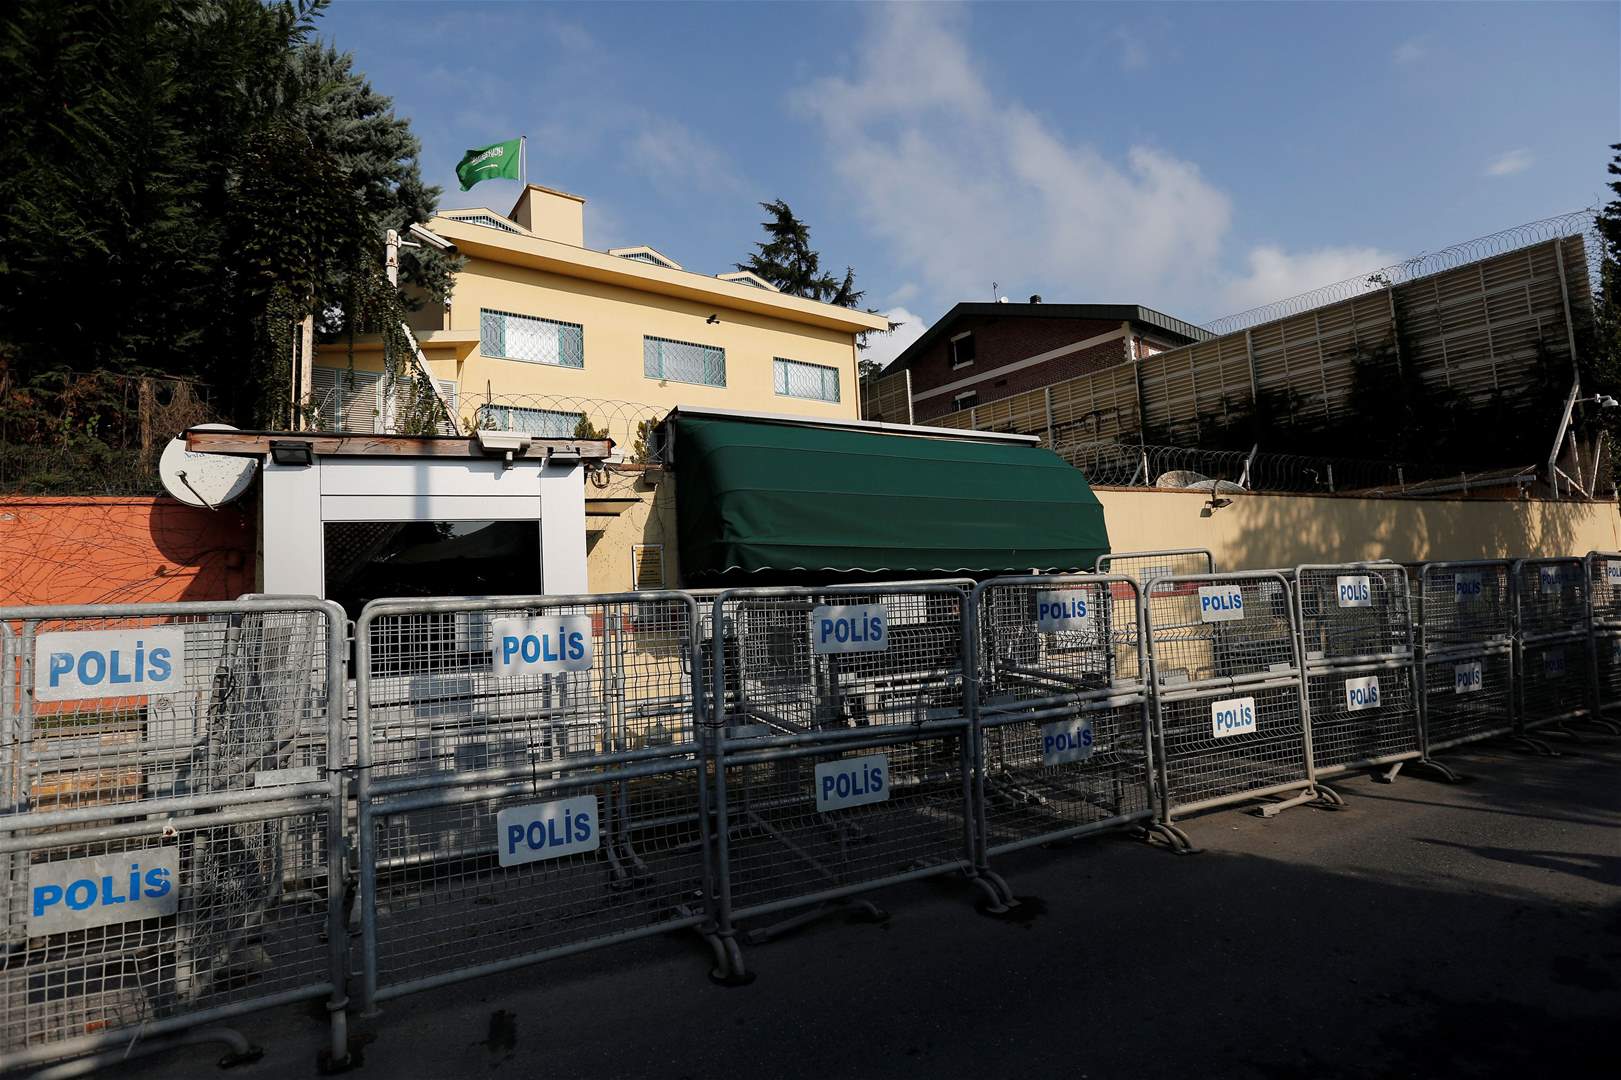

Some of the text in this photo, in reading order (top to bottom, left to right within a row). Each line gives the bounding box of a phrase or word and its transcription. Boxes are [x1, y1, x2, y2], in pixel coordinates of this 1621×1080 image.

[1202, 592, 1242, 611] POLİS
[1341, 581, 1368, 601] POLİS
[1040, 598, 1086, 621] POLİS
[821, 612, 883, 643] POLİS
[503, 627, 585, 665] POLİS
[49, 641, 172, 687] POLİS
[1457, 667, 1480, 688] POLİS
[1350, 683, 1377, 706] POLİS
[1217, 704, 1252, 731] POLİS
[1044, 727, 1091, 754] POLİS
[822, 764, 883, 801] POLİS
[508, 809, 591, 854] POLİS
[33, 864, 171, 916] POLİS
